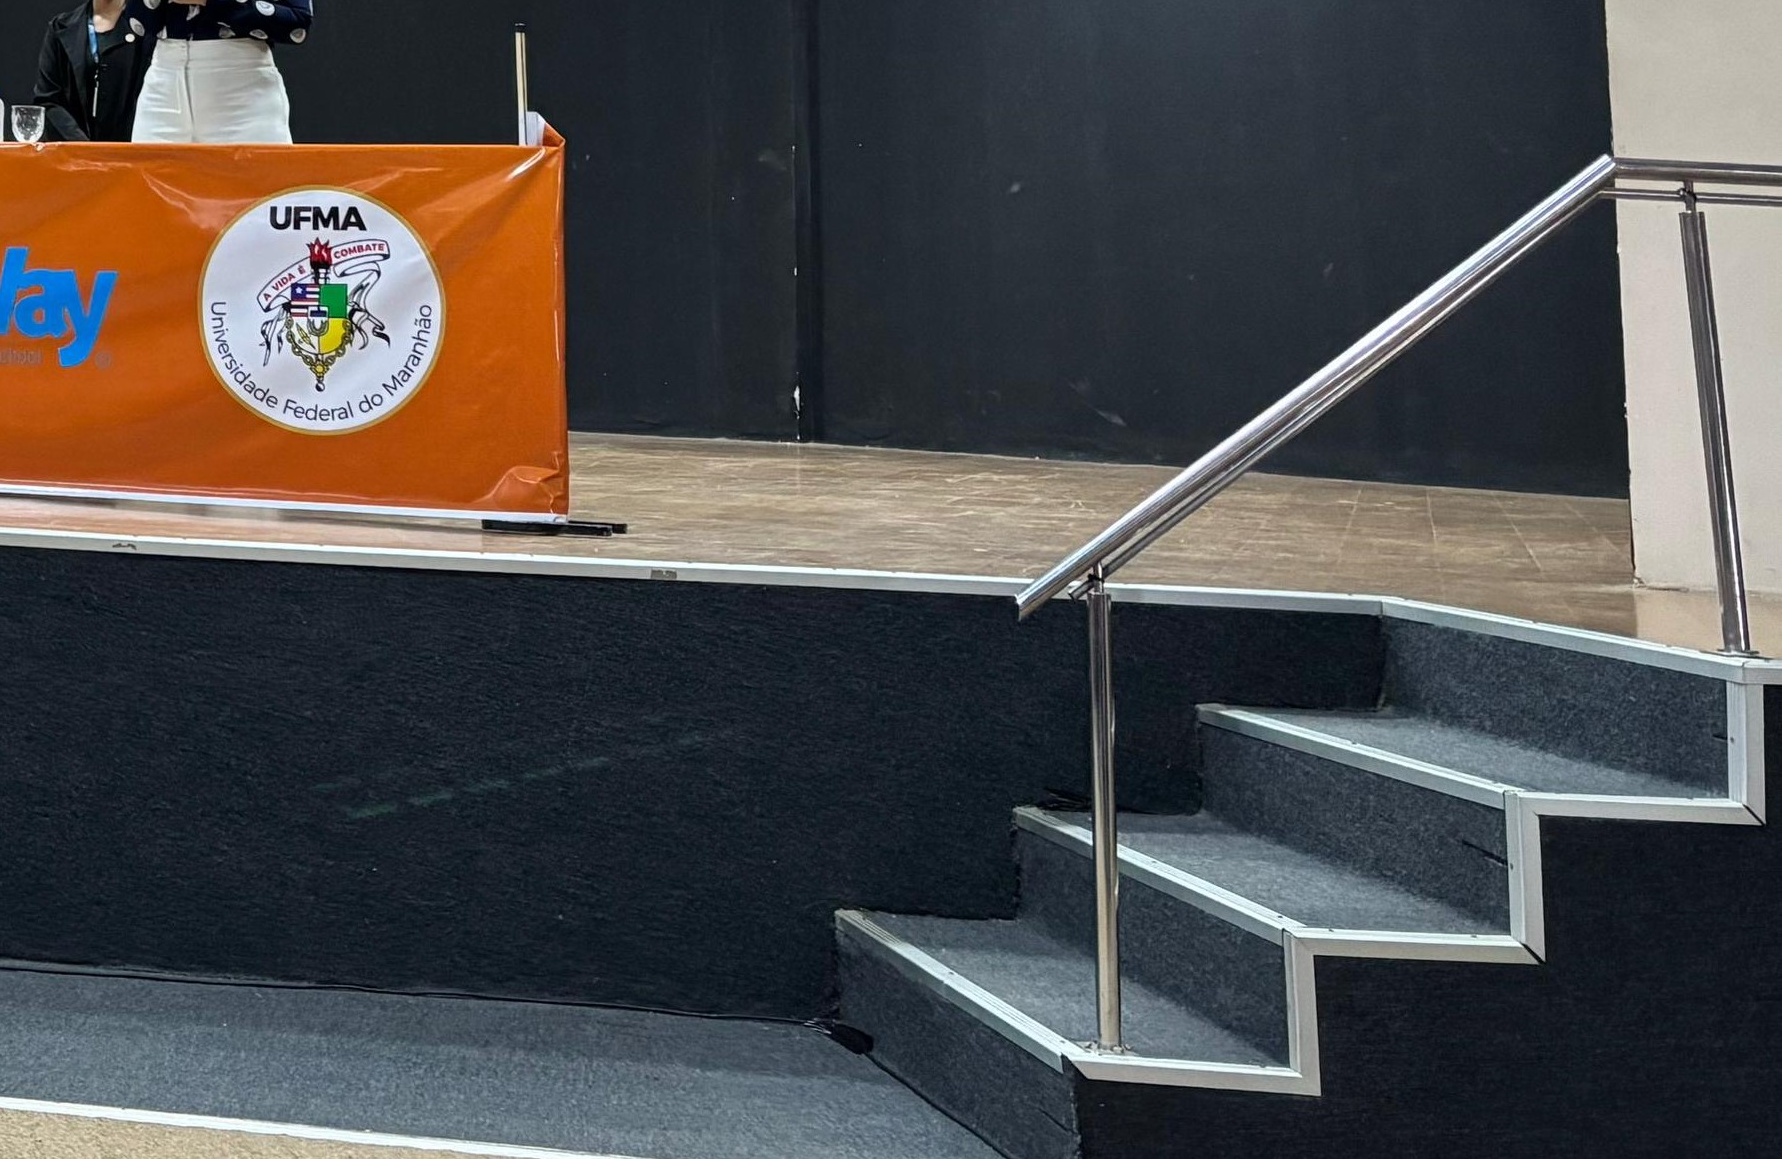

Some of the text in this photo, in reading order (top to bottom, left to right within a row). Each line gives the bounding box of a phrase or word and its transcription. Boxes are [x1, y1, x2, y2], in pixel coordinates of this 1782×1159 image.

[269, 206, 367, 231] UFMA
[263, 243, 385, 302] A VIDA É COMBATE
[211, 301, 433, 422] Universidade Federal do Maranhão
